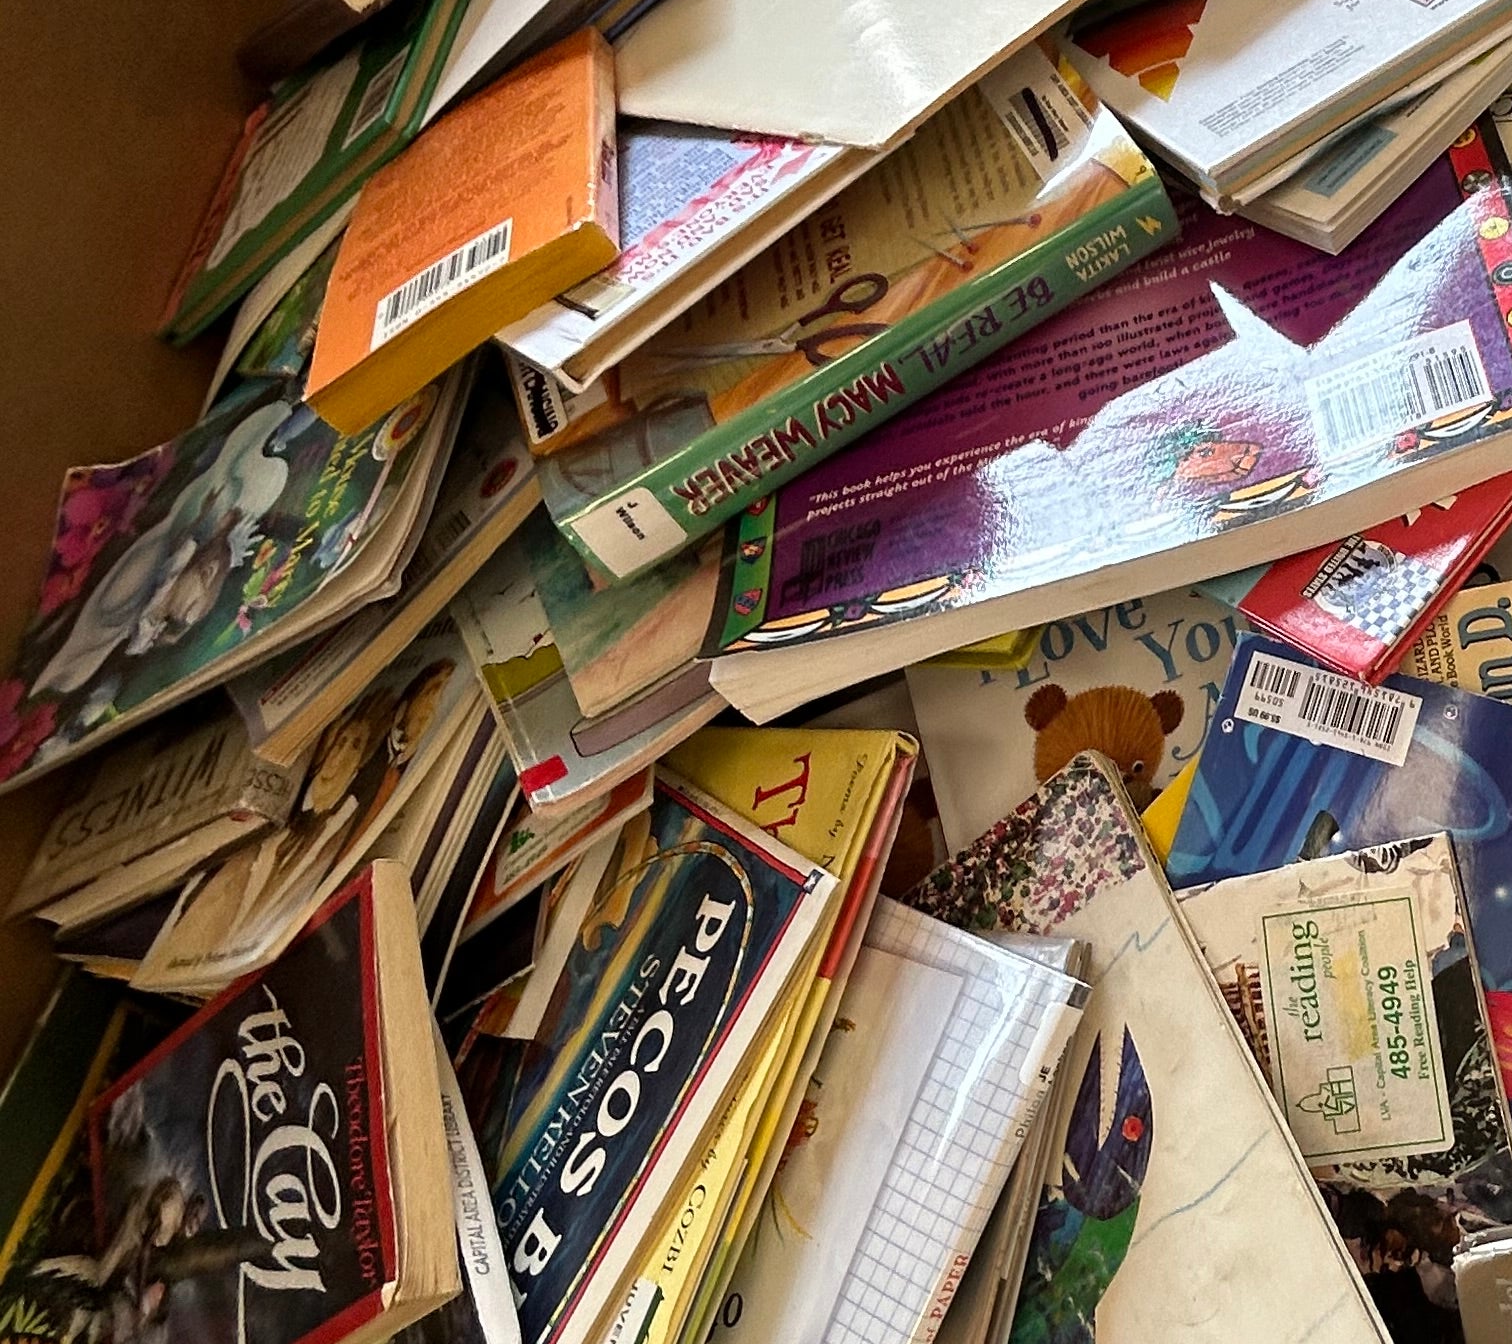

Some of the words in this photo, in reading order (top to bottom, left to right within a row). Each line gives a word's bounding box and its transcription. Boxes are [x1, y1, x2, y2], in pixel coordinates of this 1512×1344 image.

[1065, 225, 1128, 271] WILSON
[1074, 242, 1129, 281] LAKITA
[1192, 249, 1230, 271] castle
[1000, 271, 1054, 318] BE
[1052, 328, 1095, 354] period
[1098, 319, 1132, 338] than
[1057, 344, 1087, 362] than
[1113, 317, 1186, 344] illustrated
[1077, 381, 1119, 401] going
[1084, 364, 1120, 382] there
[812, 361, 903, 438] MACY
[668, 415, 815, 514] WEAVER
[841, 478, 871, 495] book
[874, 469, 908, 485] helps
[909, 462, 932, 477] you
[934, 441, 1003, 467] experience
[1004, 432, 1027, 447] the
[1028, 426, 1048, 440] era
[805, 498, 855, 521] projects
[858, 481, 908, 503] straight
[909, 473, 932, 487] out
[950, 460, 972, 475] the
[614, 505, 647, 542] Wilson
[1254, 691, 1285, 707] 50599
[1258, 709, 1282, 724] $5.99
[1288, 920, 1323, 1041] reading
[1311, 936, 1337, 980] people
[1403, 959, 1419, 991] Help
[1282, 996, 1299, 1017] the
[1361, 978, 1377, 1028] Literacy
[1377, 966, 1410, 1079] 485-4949
[1408, 993, 1426, 1047] Reading
[238, 986, 315, 1121] the
[560, 896, 734, 1194] PECOS
[567, 954, 659, 1109] STEVEN
[1369, 1029, 1382, 1053] Area
[1037, 1064, 1052, 1082] JE
[1416, 1050, 1430, 1080] Free
[573, 1071, 603, 1126] RETOLD
[345, 1055, 365, 1192] Theodore
[492, 1107, 571, 1225] KELLO
[462, 1188, 483, 1223] AREA
[660, 1182, 706, 1271] COZBI
[354, 1196, 377, 1284] Taylor
[467, 1223, 491, 1275] CAPITAL
[929, 1254, 968, 1322] PAPER
